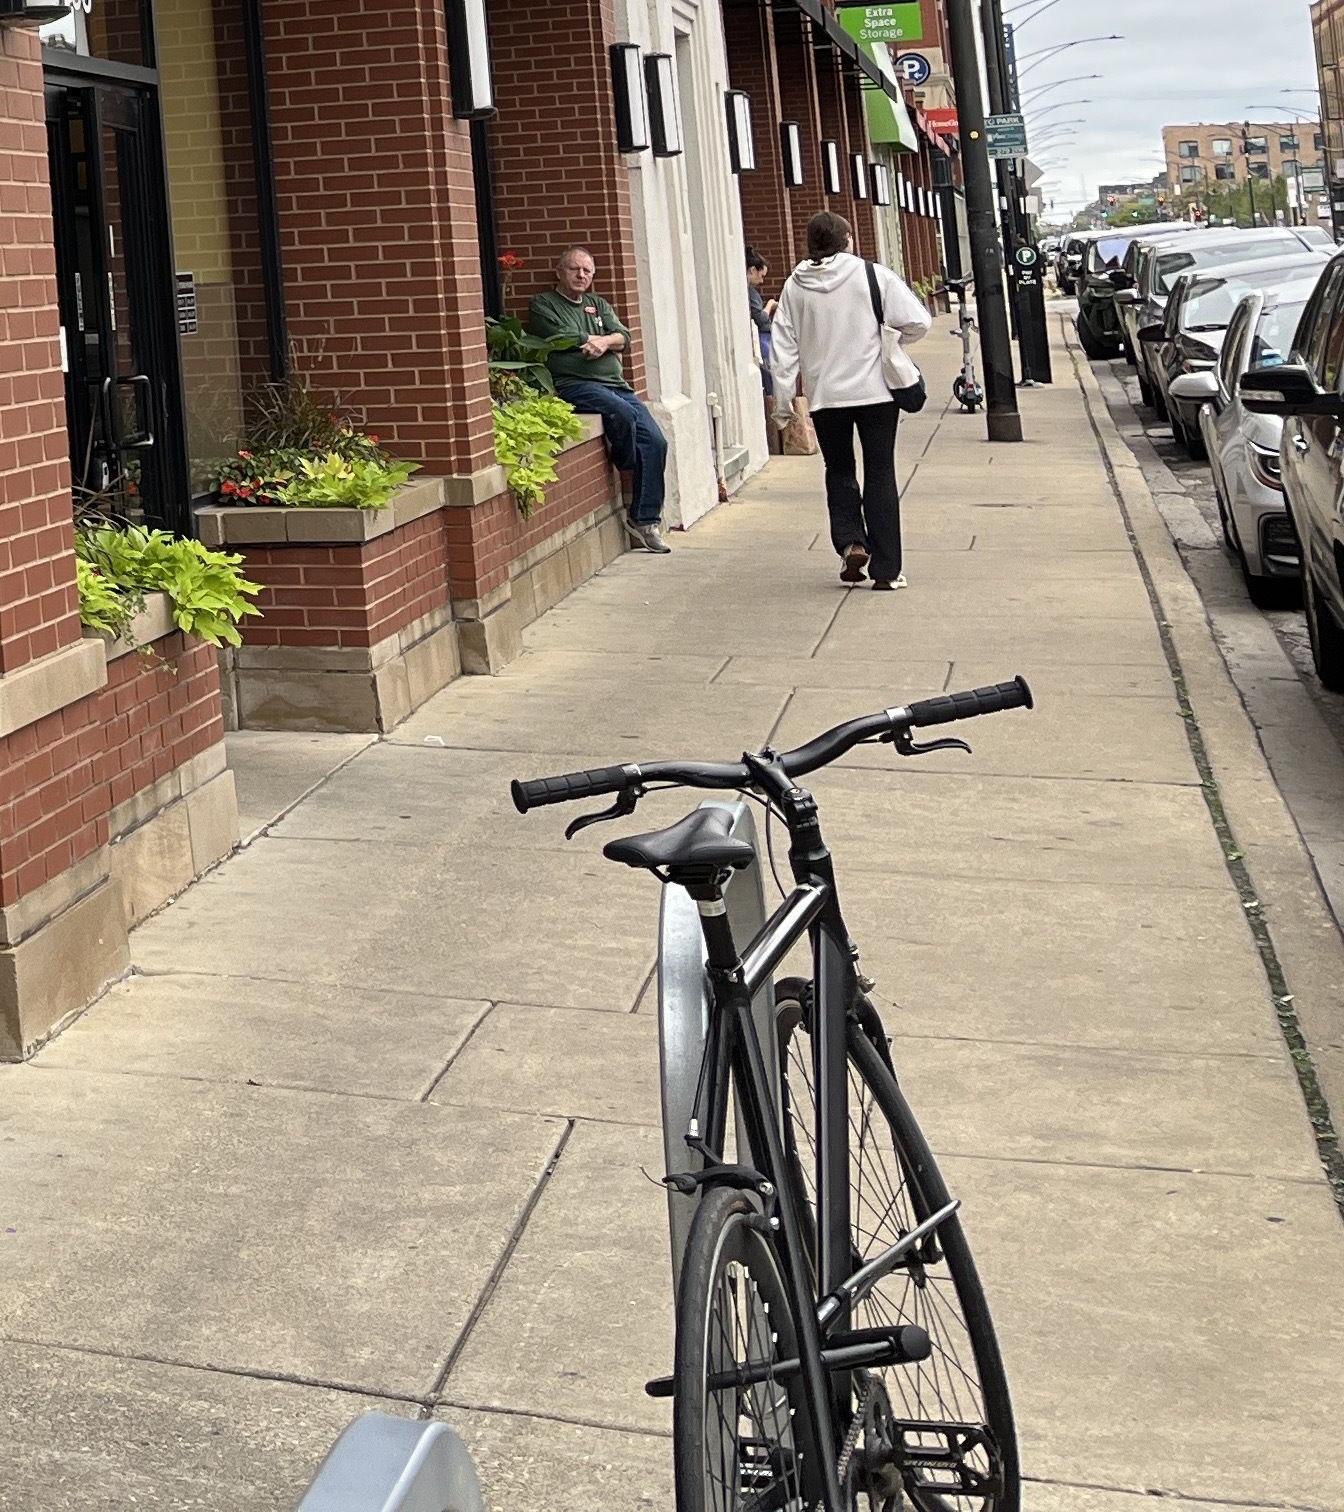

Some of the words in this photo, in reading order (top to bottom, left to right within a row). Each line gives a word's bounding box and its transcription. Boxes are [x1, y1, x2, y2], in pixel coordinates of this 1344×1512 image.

[865, 8, 893, 18] Extra
[864, 18, 897, 29] Space
[859, 28, 904, 40] Storage
